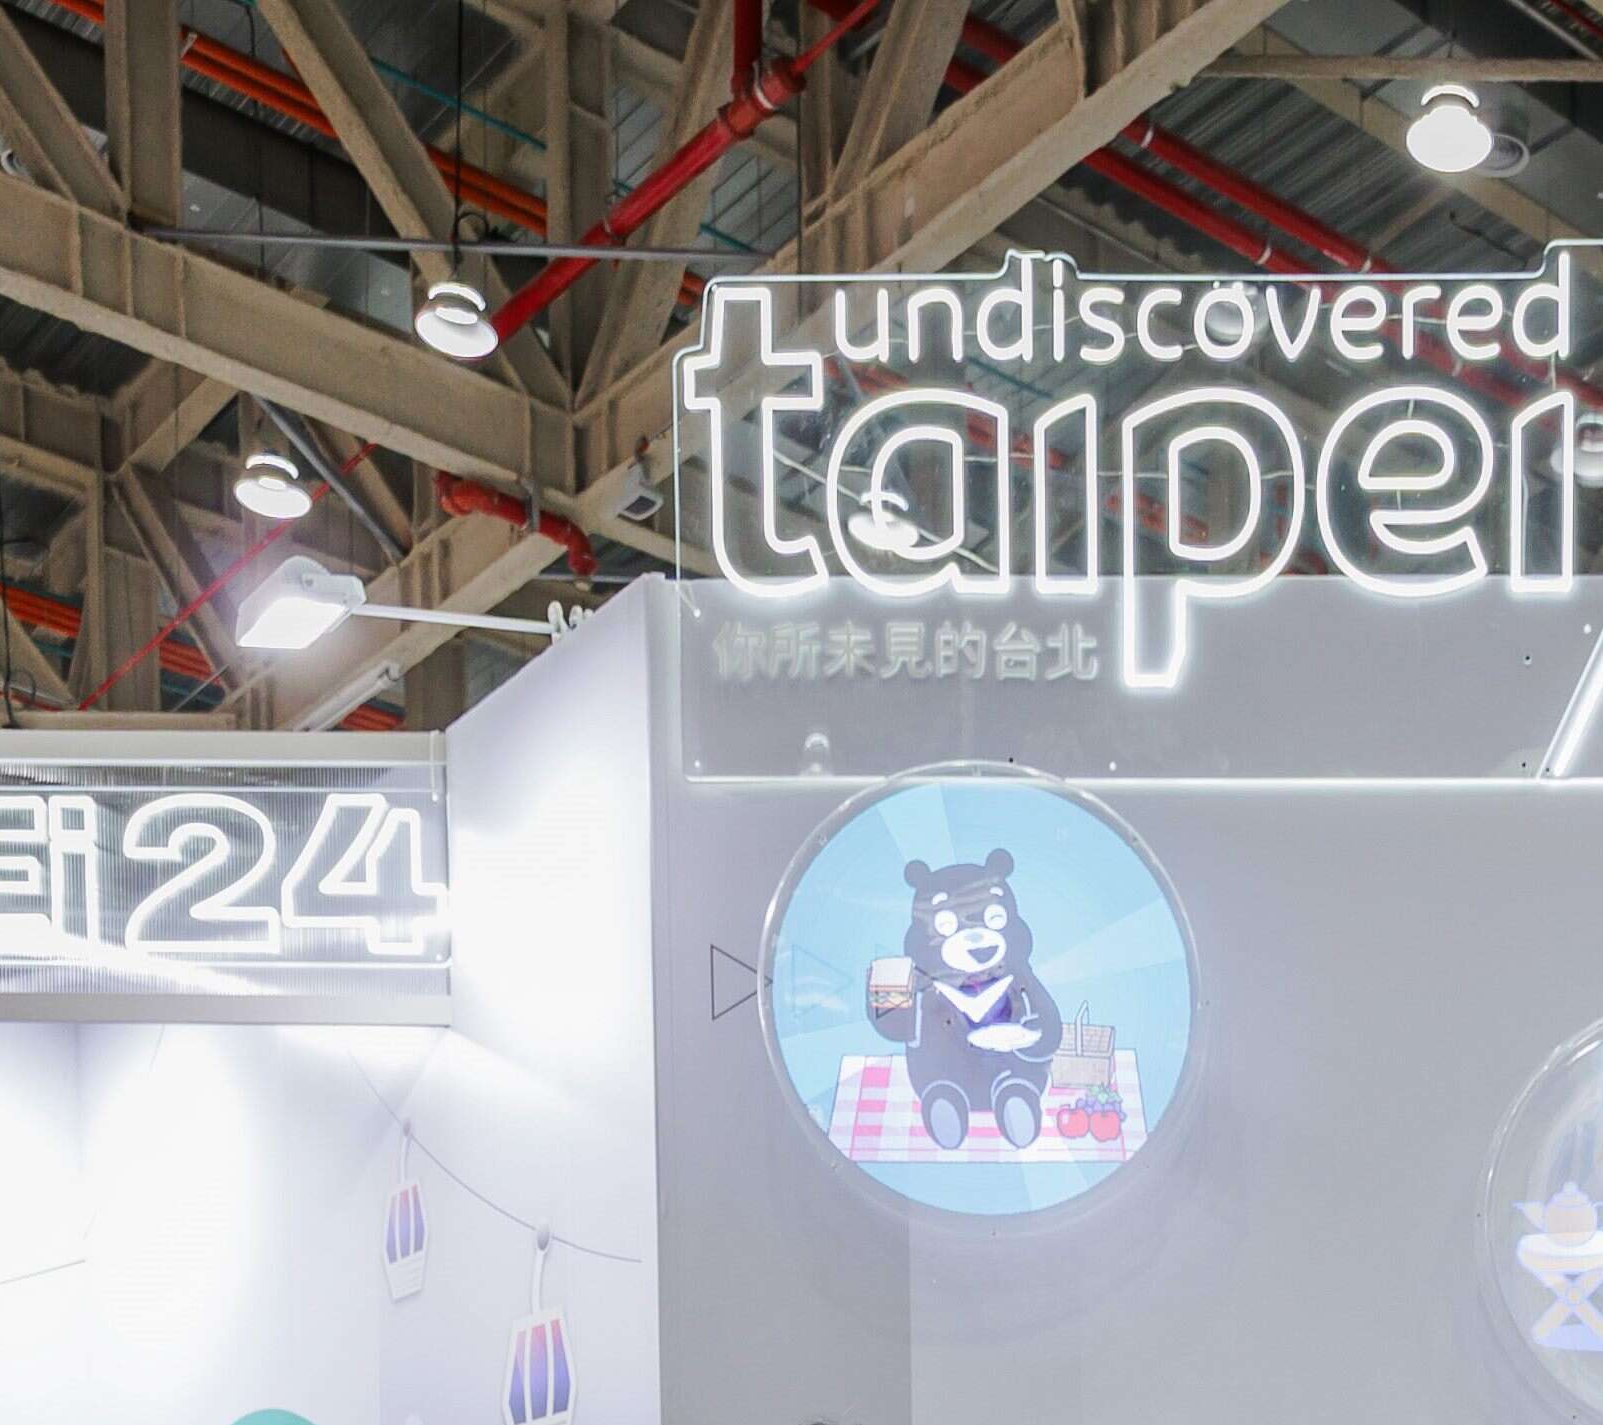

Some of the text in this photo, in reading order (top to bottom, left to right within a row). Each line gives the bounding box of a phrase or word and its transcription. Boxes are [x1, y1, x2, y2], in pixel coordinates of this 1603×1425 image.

[832, 248, 1572, 364] undiscovered
[712, 618, 1100, 682] 你所未見的台北
